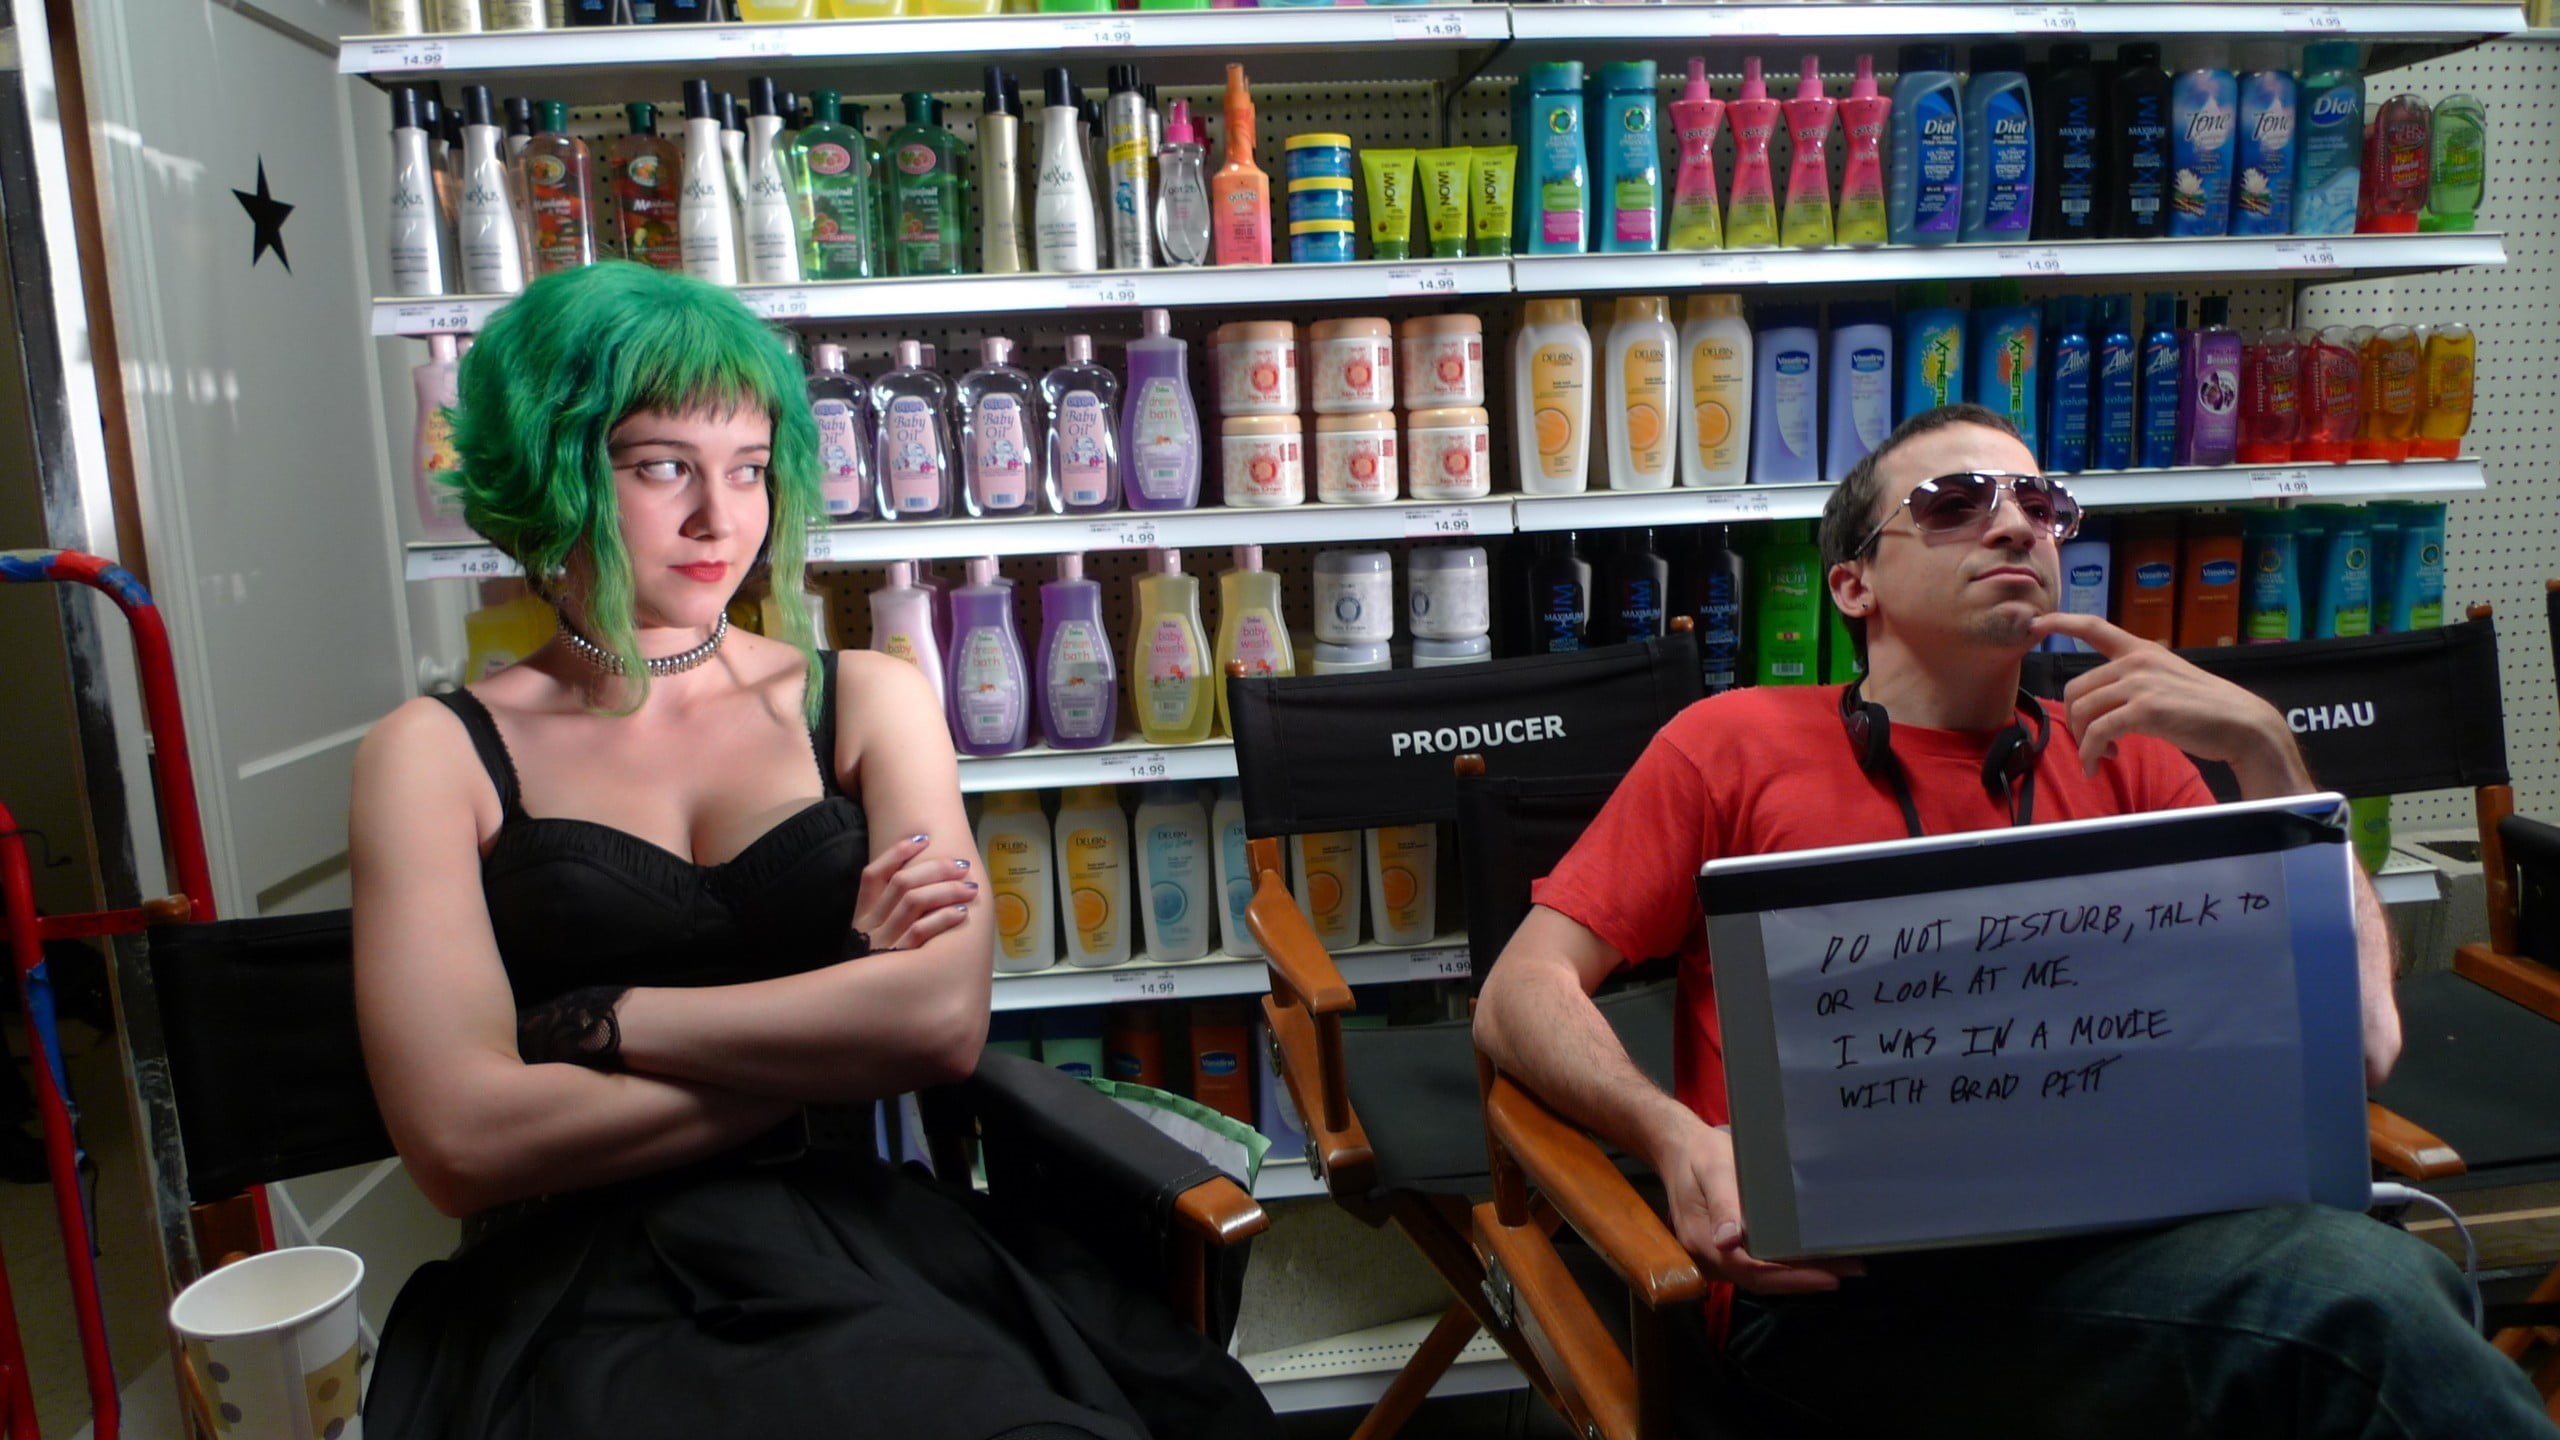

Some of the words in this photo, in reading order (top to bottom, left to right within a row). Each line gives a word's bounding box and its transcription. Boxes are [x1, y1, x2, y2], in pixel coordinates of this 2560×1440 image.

[2043, 17, 2077, 29] 14.99
[2310, 17, 2341, 28] 14.99
[1425, 23, 1462, 36] 14.99
[1094, 31, 1132, 42] 14.99
[403, 54, 442, 66] 14.99
[2314, 97, 2353, 116] Dial
[1924, 120, 1956, 135] Dial
[1995, 120, 2028, 135] Dial
[2185, 112, 2231, 140] Tone
[2303, 253, 2335, 264] 14.99
[2026, 260, 2060, 272] 14.99
[1418, 278, 1455, 290] 14.99
[1098, 290, 1136, 301] 14.99
[428, 316, 468, 328] 14.99
[1066, 411, 1097, 428] Baby
[1150, 408, 1177, 419] bath
[818, 417, 846, 436] Baby
[894, 415, 926, 433] Baby
[982, 412, 1014, 429] Baby
[897, 429, 919, 441] Oil
[985, 425, 1008, 438] Oil
[1068, 423, 1092, 436] Oil
[2278, 482, 2309, 493] 14.99
[1434, 520, 1469, 532] 14.99
[1120, 534, 1155, 544] 14.99
[461, 563, 499, 573] 14.99
[1622, 609, 1662, 619] MAXIMUM
[1700, 604, 1738, 614] MAXIMUM
[1545, 612, 1585, 621] MAXIMUM
[1158, 630, 1181, 643] baby
[1243, 626, 1266, 638] baby
[1156, 644, 1185, 653] wash
[1241, 638, 1270, 649] wash
[973, 655, 1000, 667] bath
[1063, 650, 1090, 661] bath
[2286, 701, 2375, 733] CHAU
[1392, 715, 1566, 757] PRODUCER
[1130, 765, 1165, 776] 14.99
[1157, 831, 1188, 839] DELON
[996, 840, 1028, 849] DELON
[1076, 837, 1107, 846] DELON
[1820, 934, 1870, 973] DO
[1894, 918, 1952, 960] NOT
[1976, 905, 2134, 952] DISTURB,
[2145, 893, 2221, 931] TALK
[1438, 961, 1471, 974] 14.99
[1140, 982, 1175, 995] 14.99
[1817, 989, 1854, 1016] OR
[1874, 971, 1952, 1004] LOOK
[1968, 965, 2006, 995] AT
[2022, 955, 2078, 989] ME.
[1834, 1034, 1858, 1069] I
[1879, 1027, 1936, 1058] WAS
[1962, 1018, 2015, 1056] IN
[2031, 1021, 2048, 1050] A
[2070, 1008, 2173, 1046] MOVIE
[1840, 1076, 1928, 1109] WITH
[1951, 1073, 2020, 1104] BRAD
[2042, 1054, 2122, 1098] PITT
